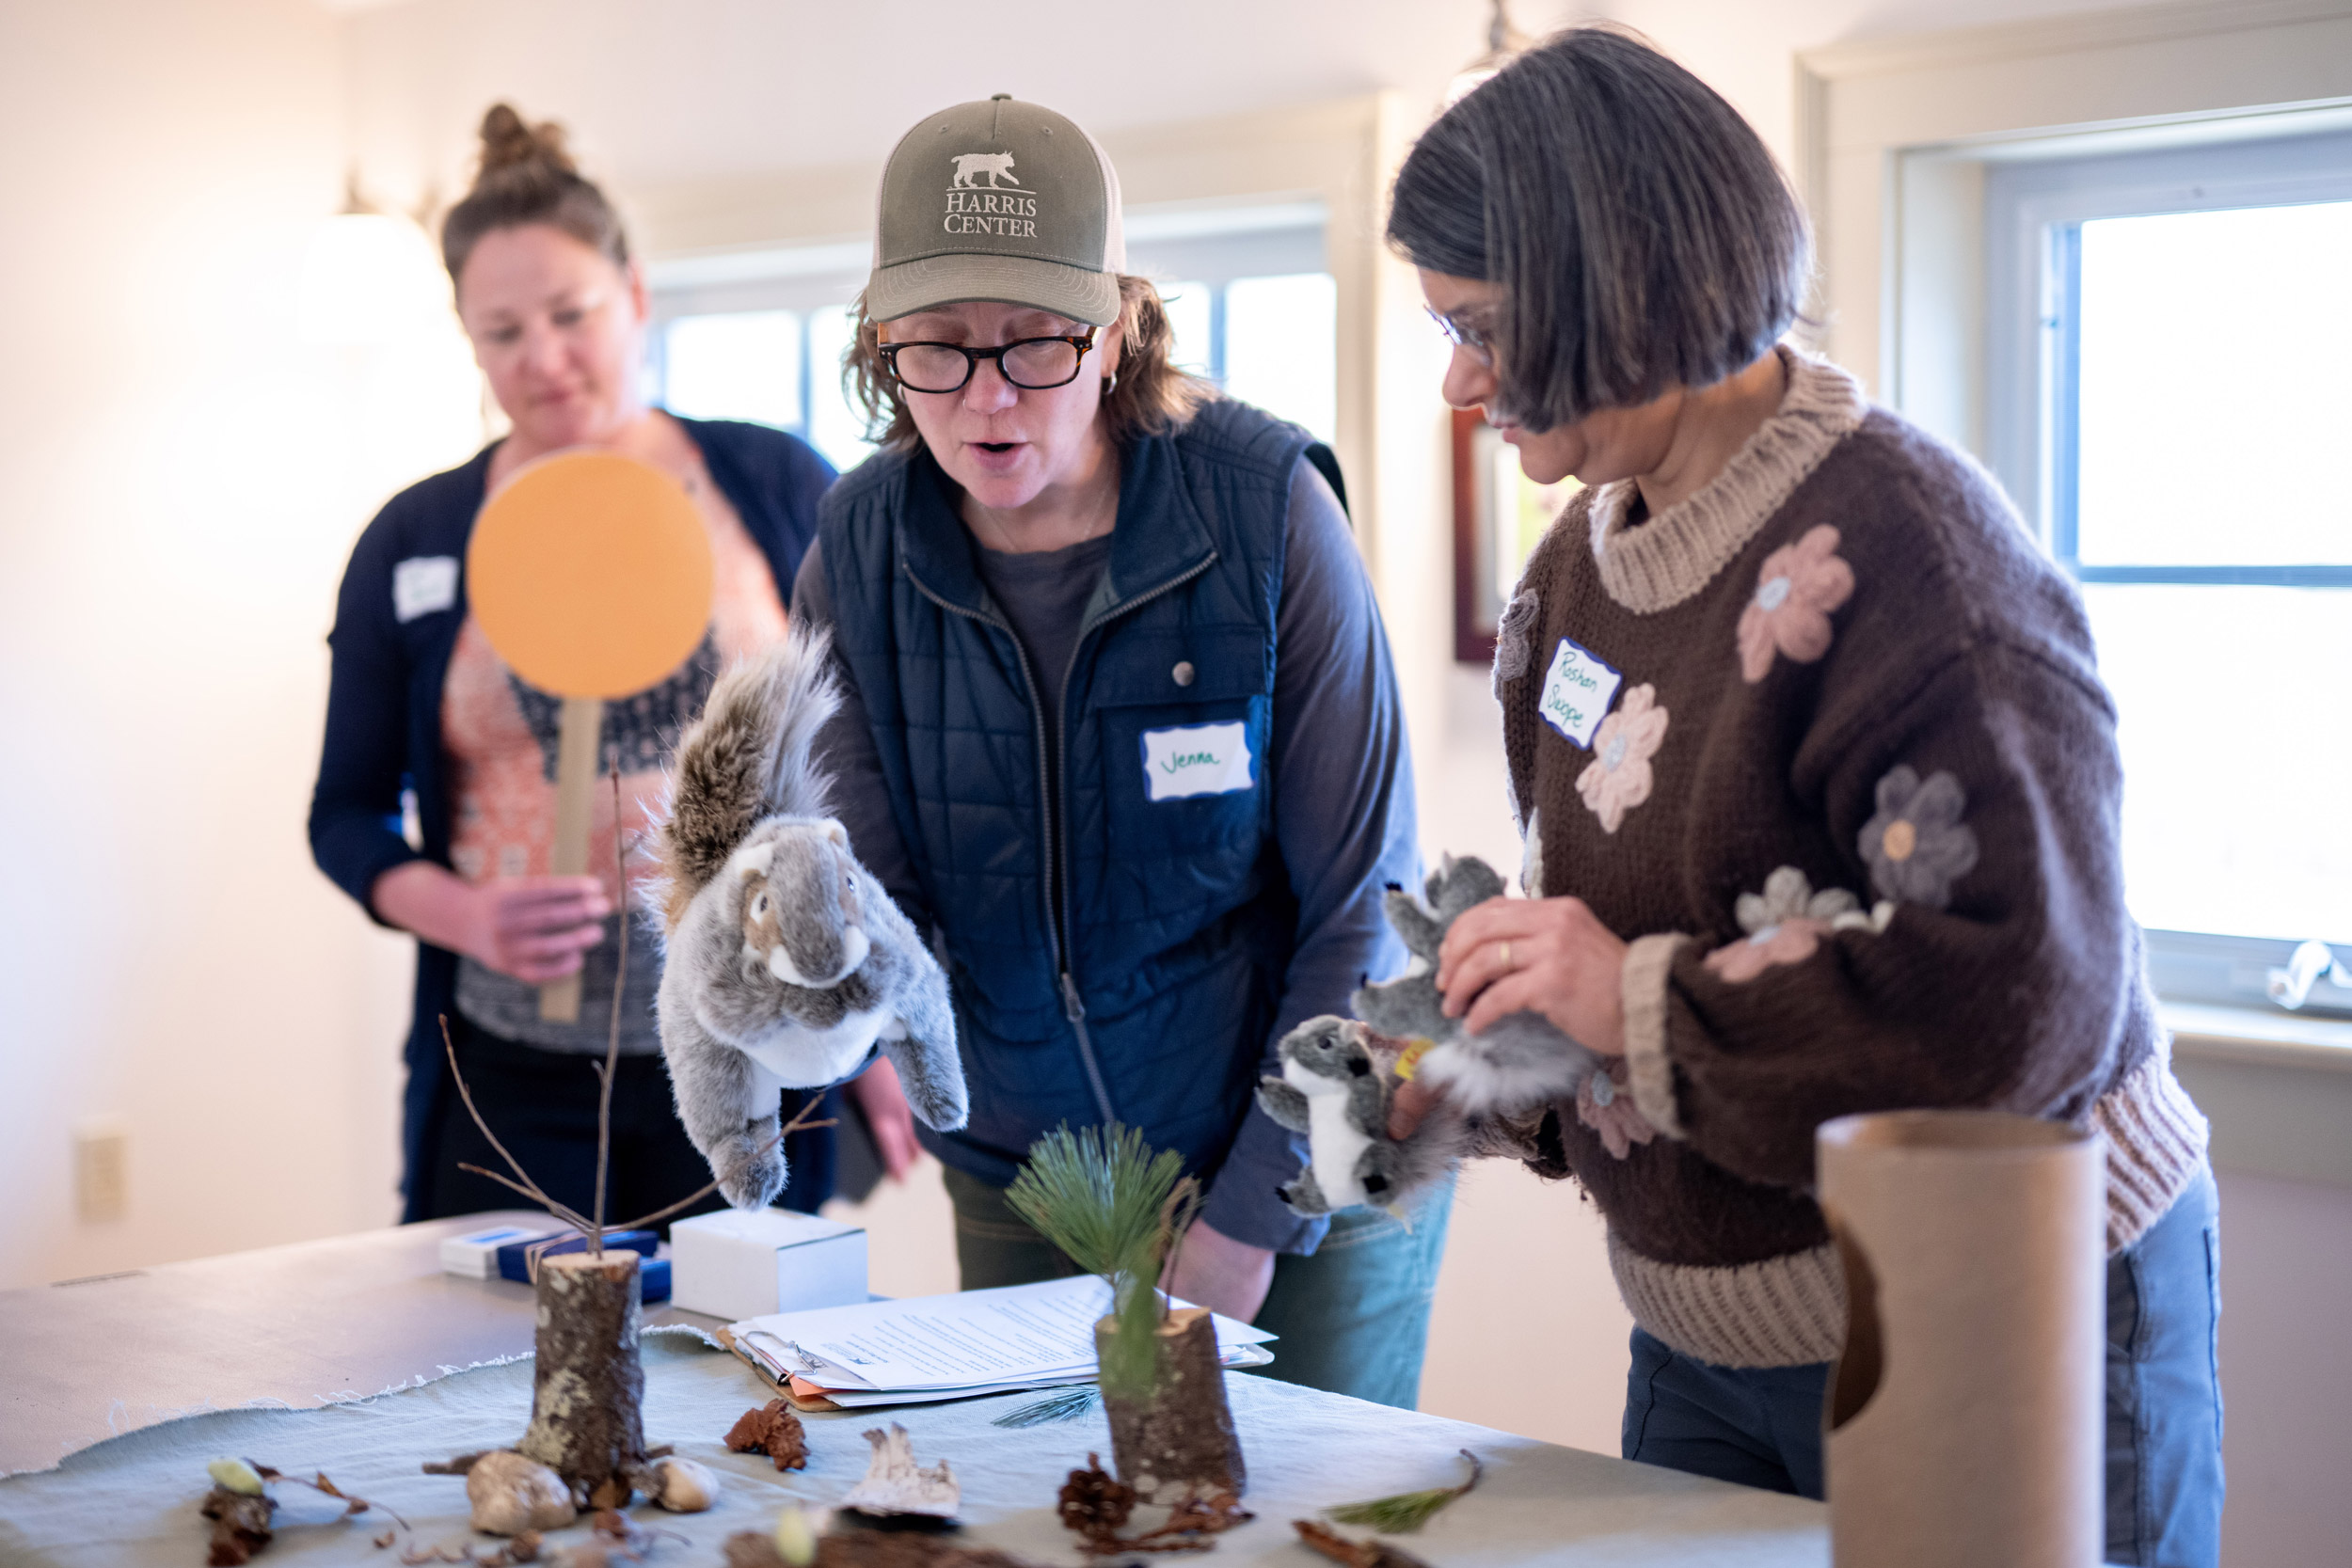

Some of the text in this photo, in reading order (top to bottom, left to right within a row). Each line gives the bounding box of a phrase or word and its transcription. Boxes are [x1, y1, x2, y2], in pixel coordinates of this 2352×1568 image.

[945, 192, 1037, 217] HARRIS
[944, 214, 1038, 237] CENTER
[1161, 751, 1221, 774] Jenna
